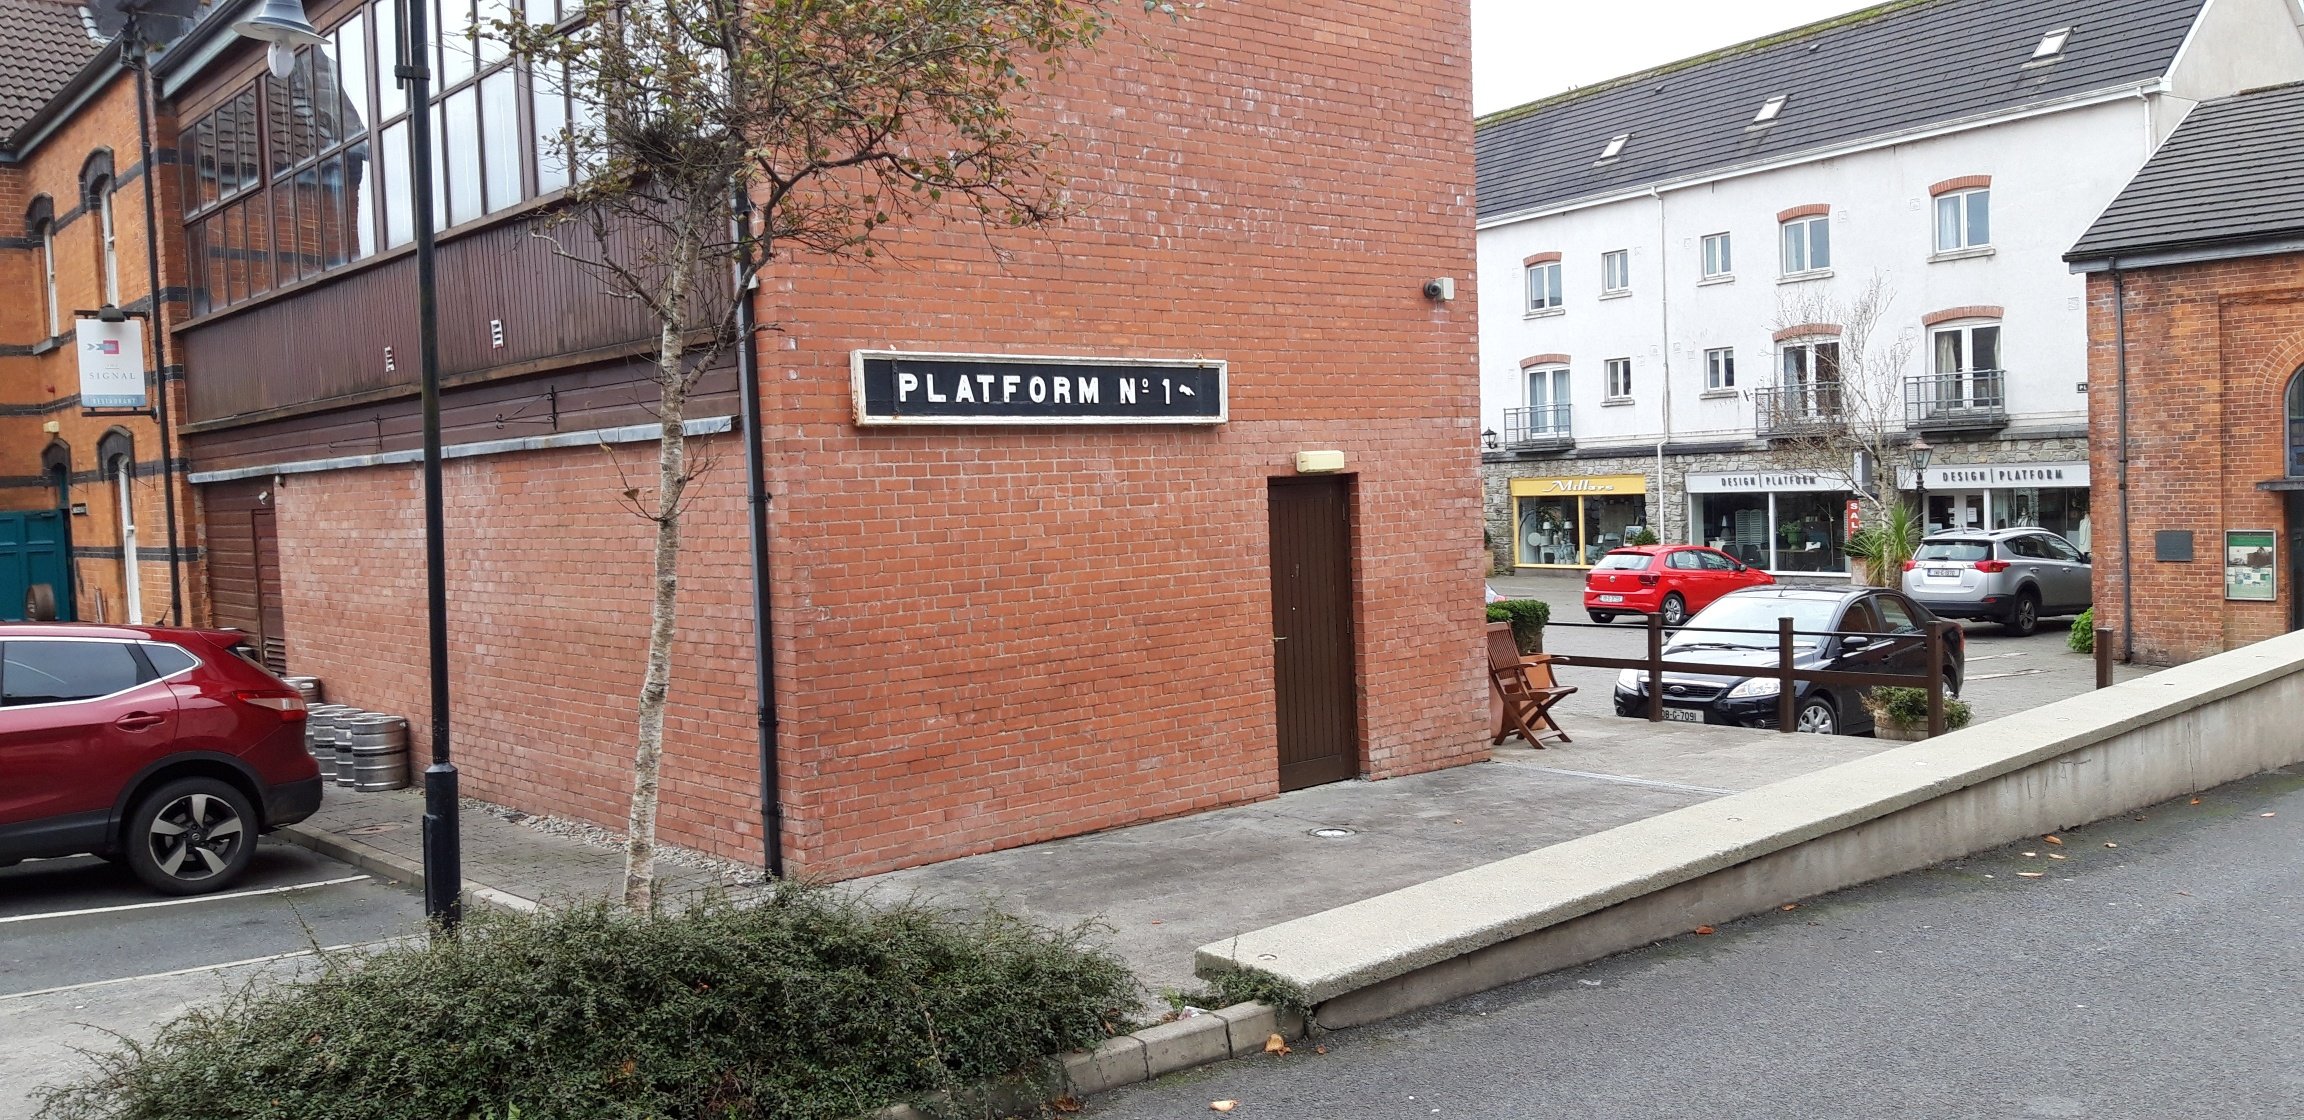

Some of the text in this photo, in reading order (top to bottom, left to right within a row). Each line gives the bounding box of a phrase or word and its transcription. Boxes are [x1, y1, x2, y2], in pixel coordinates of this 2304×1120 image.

[89, 371, 136, 380] SIGNAL
[899, 372, 1099, 405] PLATFORM
[1162, 378, 1171, 404] 1
[1721, 475, 1816, 487] DESIGN PLATFORM
[1942, 469, 2063, 482] DESIGN PLATFORM
[1542, 479, 1615, 493] Millars
[1850, 502, 1859, 533] SAL
